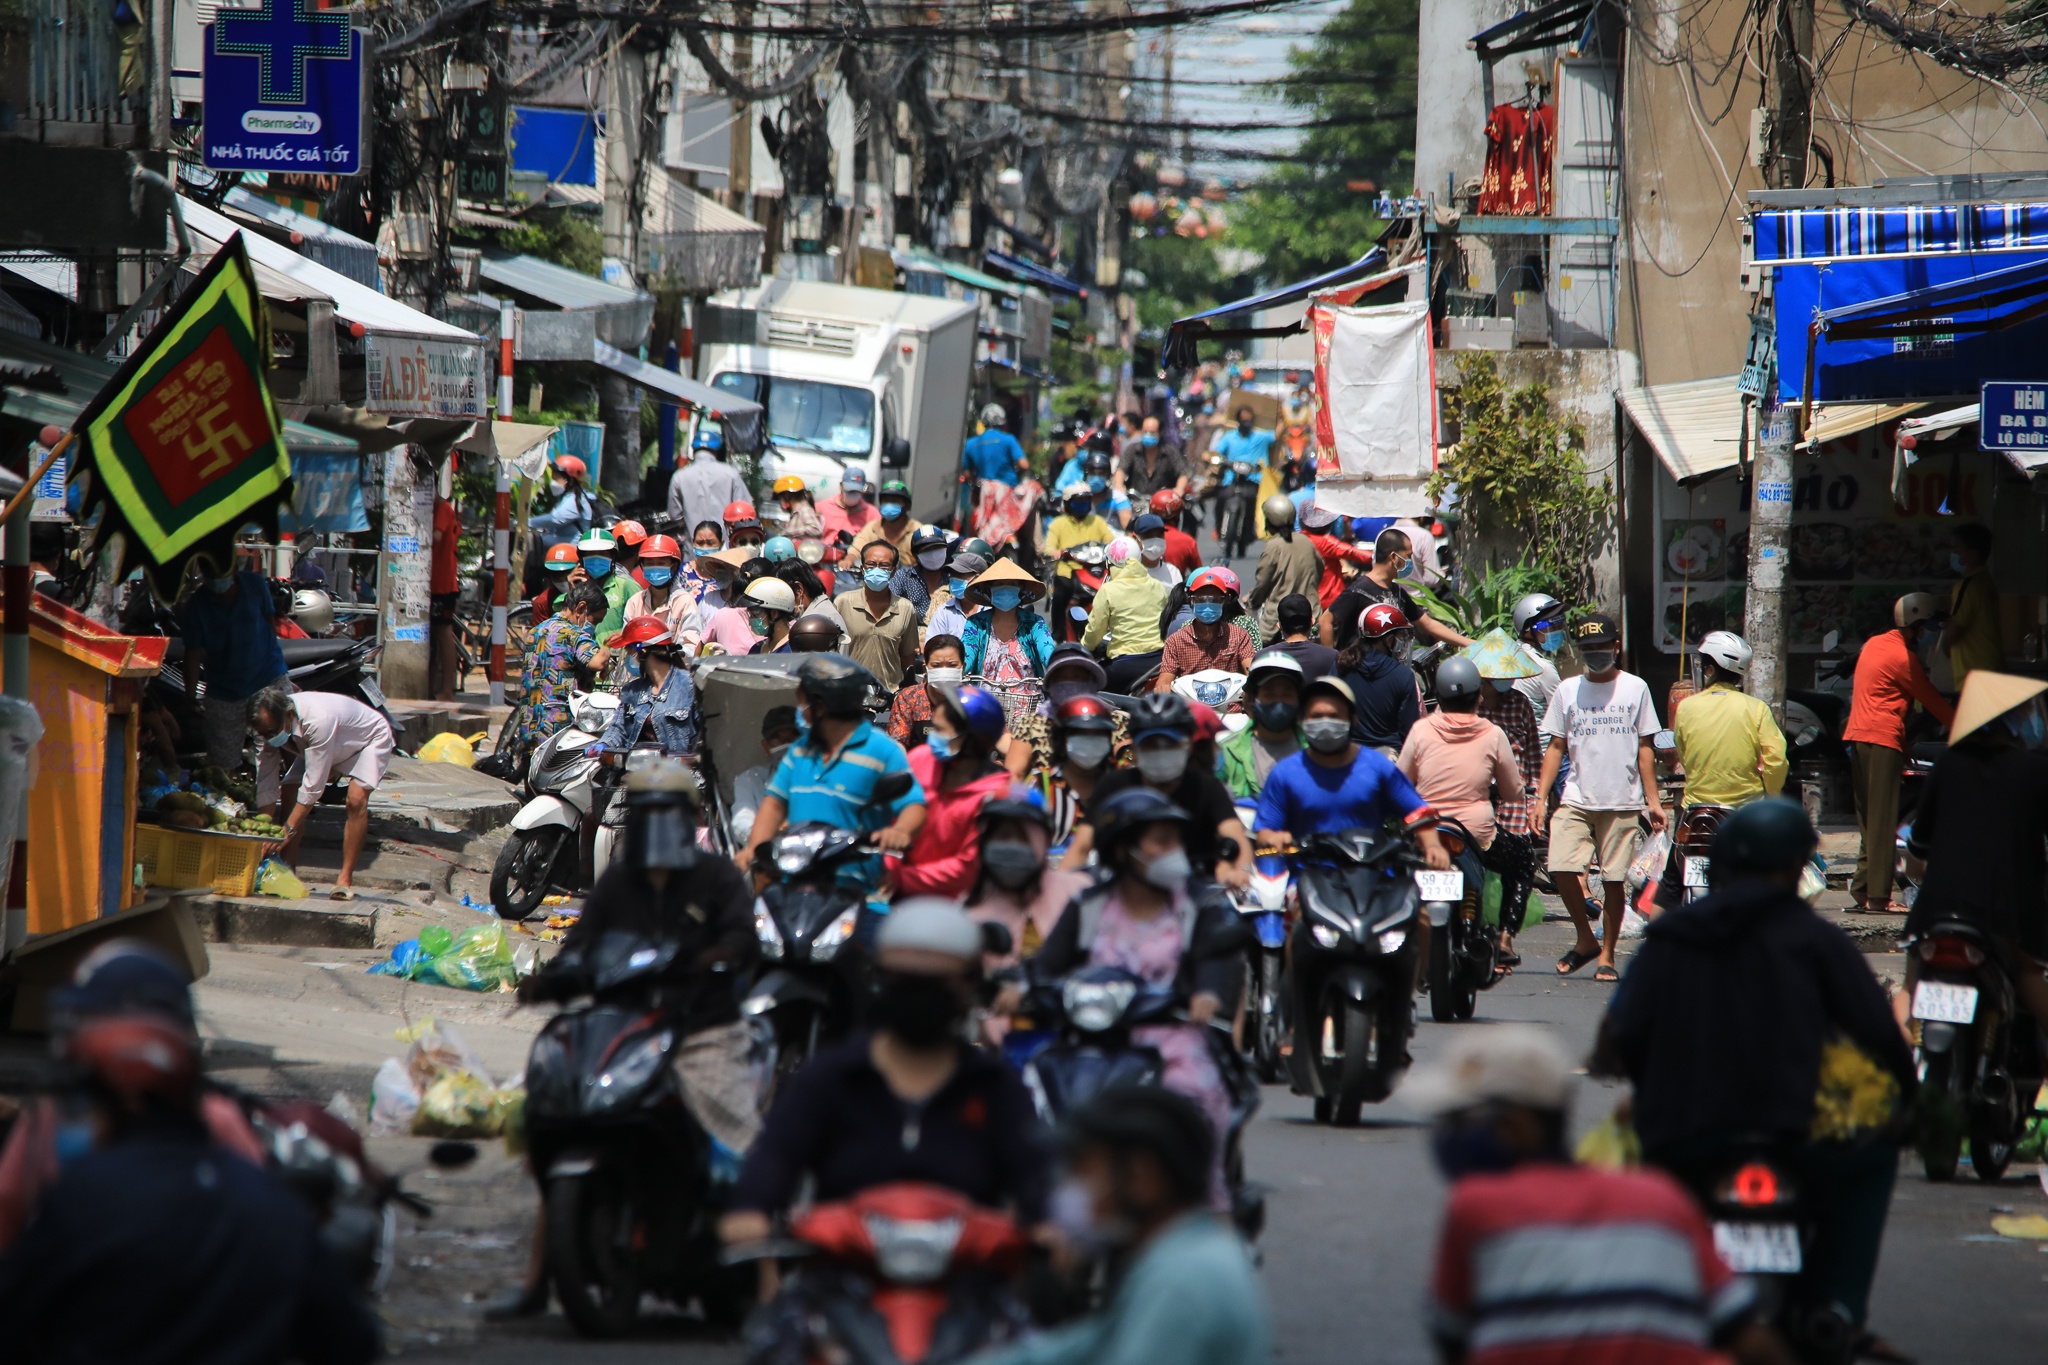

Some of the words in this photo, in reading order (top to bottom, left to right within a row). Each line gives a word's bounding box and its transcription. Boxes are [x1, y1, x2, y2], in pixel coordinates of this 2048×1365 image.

[248, 115, 315, 132] Pharmacity
[211, 143, 242, 159] NHÀ
[245, 142, 293, 160] THUỐC
[297, 146, 320, 162] GIÁ
[323, 144, 350, 162] TỐT
[2014, 385, 2045, 410] HẺM
[2000, 414, 2028, 427] BA
[2033, 413, 2048, 427] Đ
[1998, 429, 2013, 446] LỘ
[1592, 716, 1624, 725] GEORGE
[1610, 726, 1637, 735] PARI
